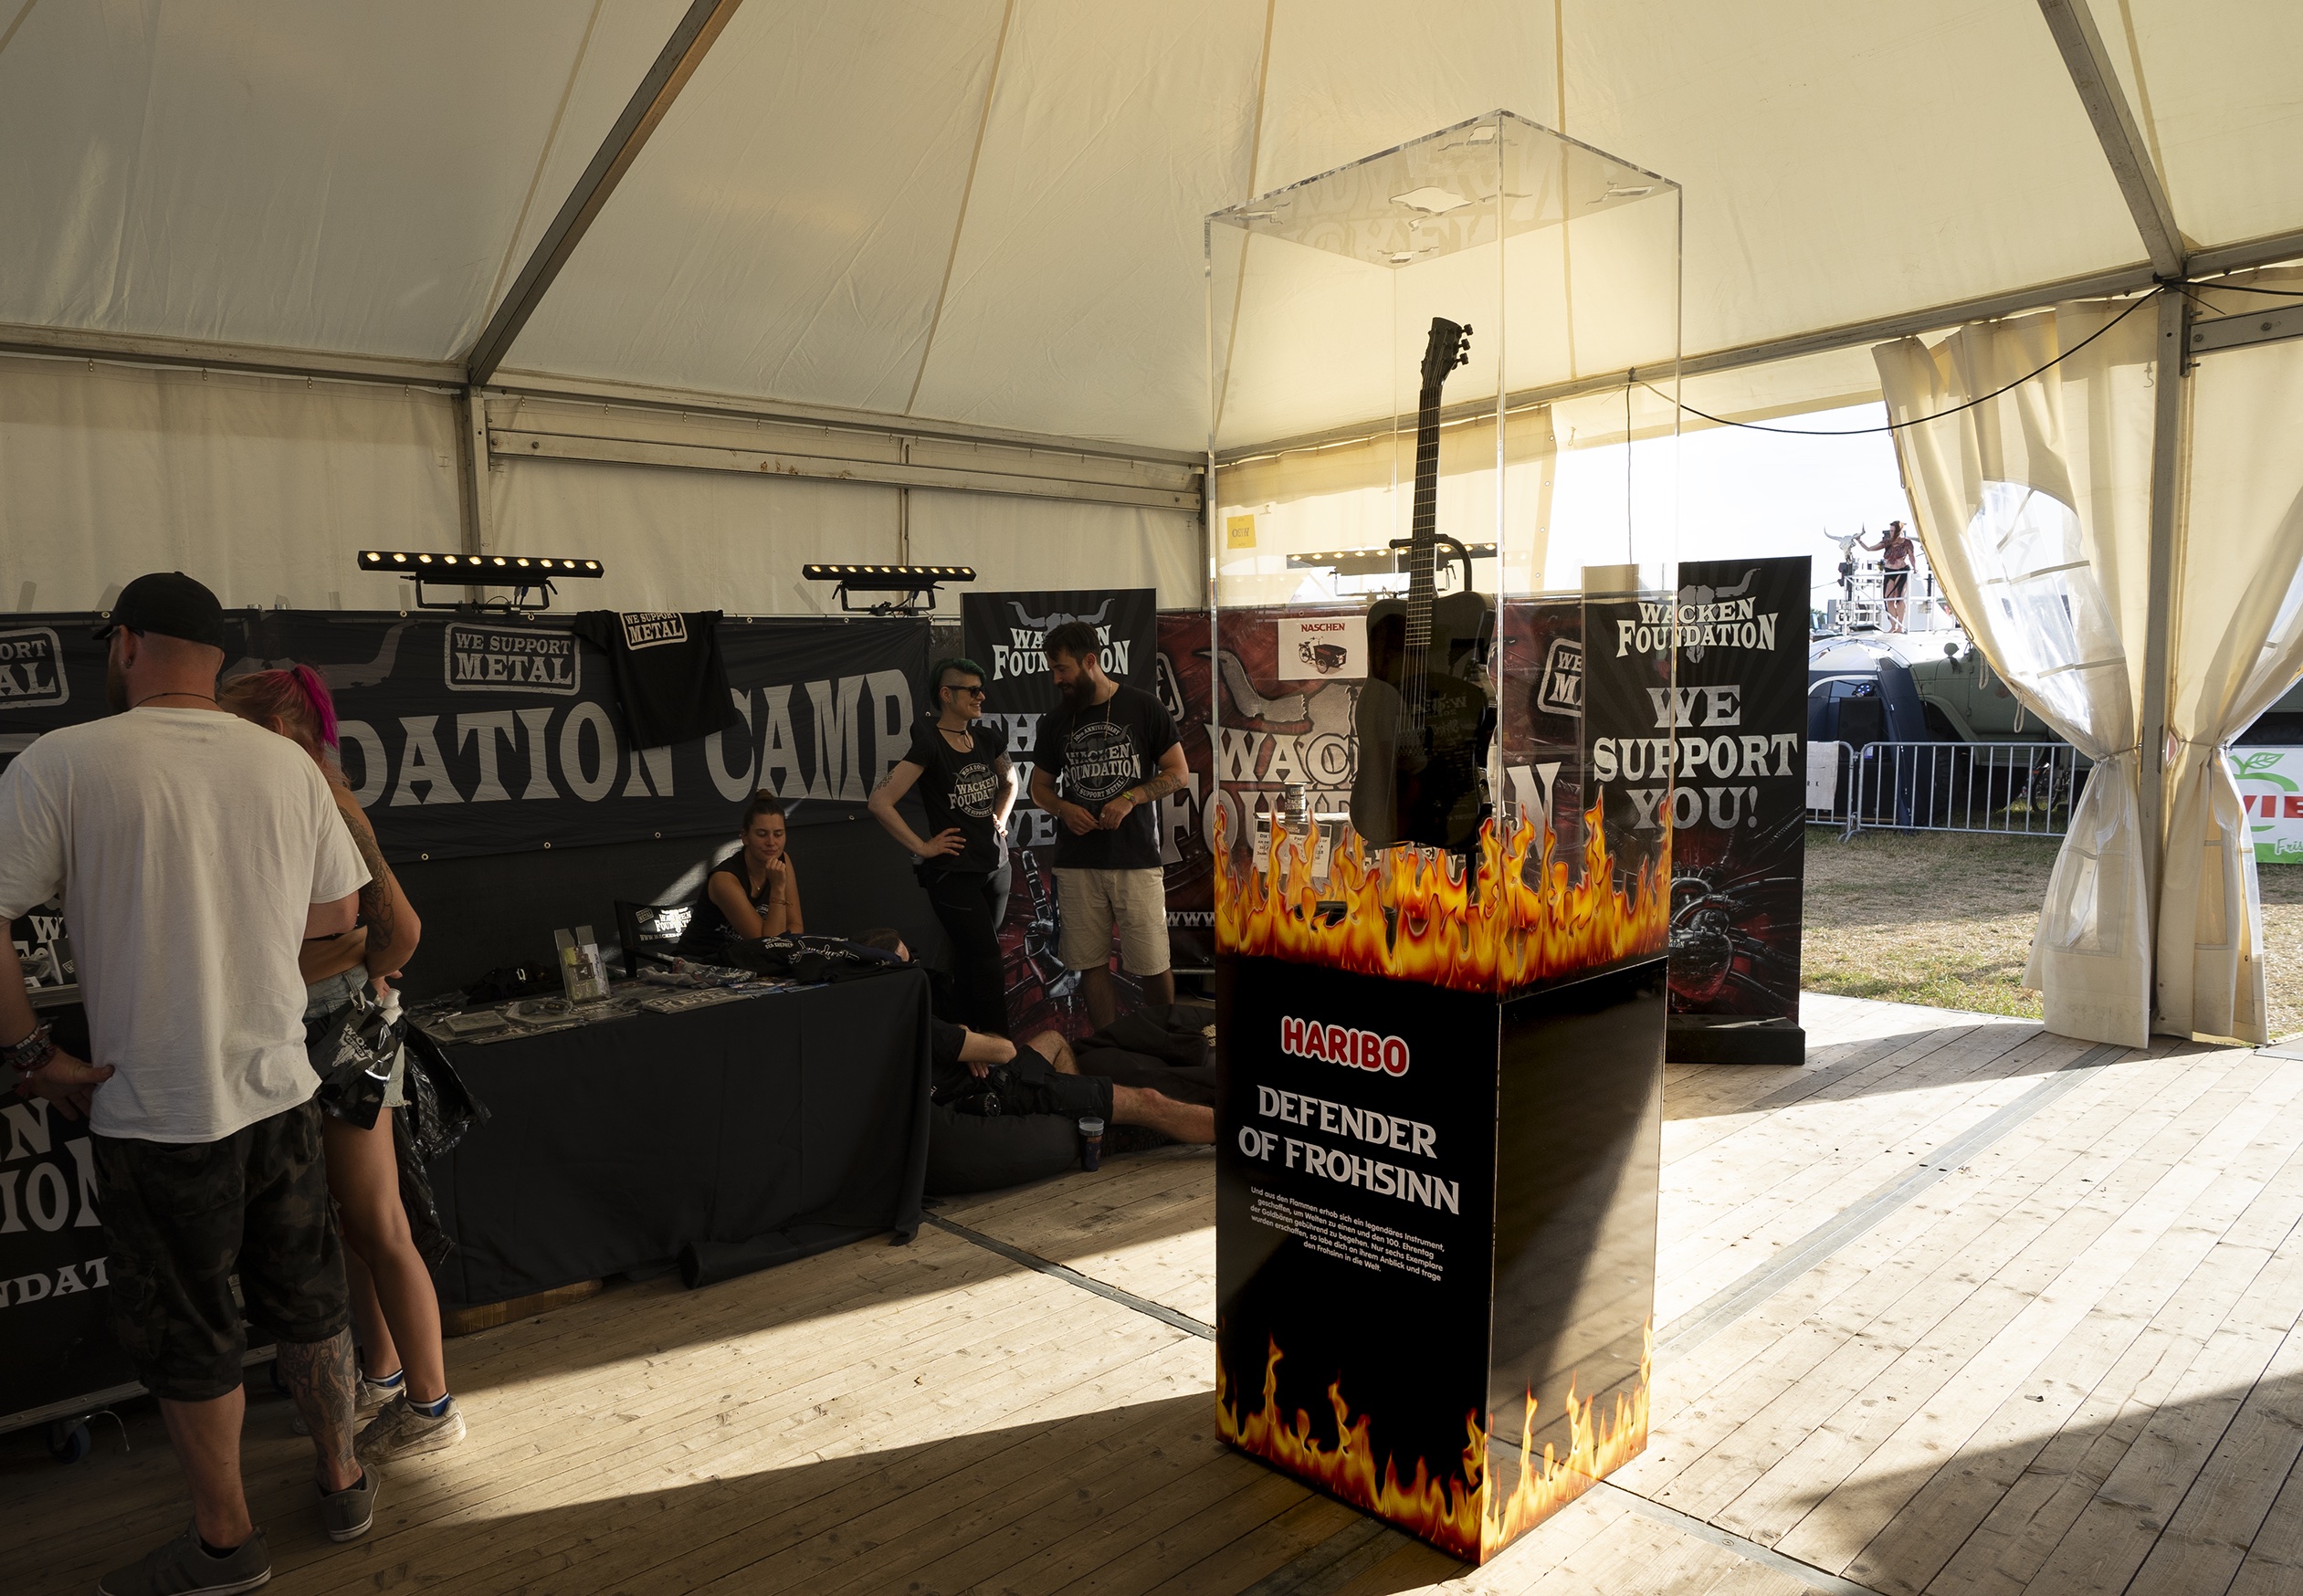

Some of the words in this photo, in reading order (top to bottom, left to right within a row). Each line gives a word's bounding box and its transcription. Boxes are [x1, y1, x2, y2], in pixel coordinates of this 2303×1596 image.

[625, 614, 640, 625] WE
[639, 612, 678, 623] SUPPORT
[1300, 623, 1346, 632] NASCHEN
[1637, 596, 1757, 625] WACKEN
[455, 633, 484, 649] WE
[489, 636, 572, 655] SUPPORT
[627, 620, 683, 644] METAL
[1009, 625, 1112, 649] WAN
[1615, 612, 1780, 658] FOUNDATION
[455, 652, 573, 685] METAL
[992, 639, 1130, 681] FOUNON
[1646, 685, 1740, 728] WE
[705, 669, 914, 803] CAMP
[1066, 742, 1130, 765] WACKEN
[1063, 754, 1141, 788] FOUNDATION
[1593, 733, 1798, 782] SUPPORT
[956, 775, 995, 794] WACKEN
[1079, 788, 1105, 799] SUPPORT
[1106, 777, 1126, 796] METAL!
[1625, 786, 1759, 830] YOU!
[1281, 1015, 1410, 1077] HARIBO
[1257, 1085, 1437, 1160] DEFENDER
[1238, 1126, 1278, 1161] OF
[1284, 1137, 1459, 1215] FROHSINN
[1251, 1186, 1264, 1196] Und
[1264, 1191, 1275, 1200] aus
[1277, 1194, 1288, 1203] den
[1289, 1198, 1318, 1213] Flammen
[1319, 1208, 1338, 1218] erhob
[1340, 1213, 1351, 1223] sich
[1353, 1218, 1364, 1227] ein
[1365, 1221, 1404, 1238] legendäres
[1404, 1233, 1445, 1253] Instrument,
[1257, 1199, 1291, 1214] geschaffen,
[1305, 1212, 1327, 1225] Welten
[1337, 1223, 1355, 1234] einen
[1357, 1229, 1370, 1238] und
[1372, 1233, 1384, 1244] den
[1386, 1236, 1401, 1248] 100.
[1403, 1242, 1434, 1260] Ehrentag
[1262, 1208, 1293, 1223] Goldbären
[1294, 1220, 1328, 1234] gebührend
[1330, 1230, 1337, 1238] zu
[1339, 1233, 1370, 1249] begehen.
[1372, 1243, 1384, 1253] Nur
[1384, 1248, 1404, 1260] sechs
[1406, 1254, 1443, 1271] Exemplare
[1251, 1215, 1274, 1227] wurden
[1275, 1222, 1309, 1239] erschaffen,
[1319, 1234, 1333, 1245] labe
[1333, 1241, 1348, 1251] dich
[1349, 1246, 1358, 1255] an
[1359, 1248, 1379, 1261] ihrem
[1380, 1255, 1404, 1269] Anblick
[1406, 1265, 1420, 1275] und
[1421, 1269, 1441, 1282] trage
[1303, 1240, 1316, 1251] den
[1317, 1244, 1343, 1259] Frohsinn
[1344, 1253, 1351, 1262] in
[1352, 1256, 1362, 1265] die
[1364, 1260, 1381, 1272] Welt.
